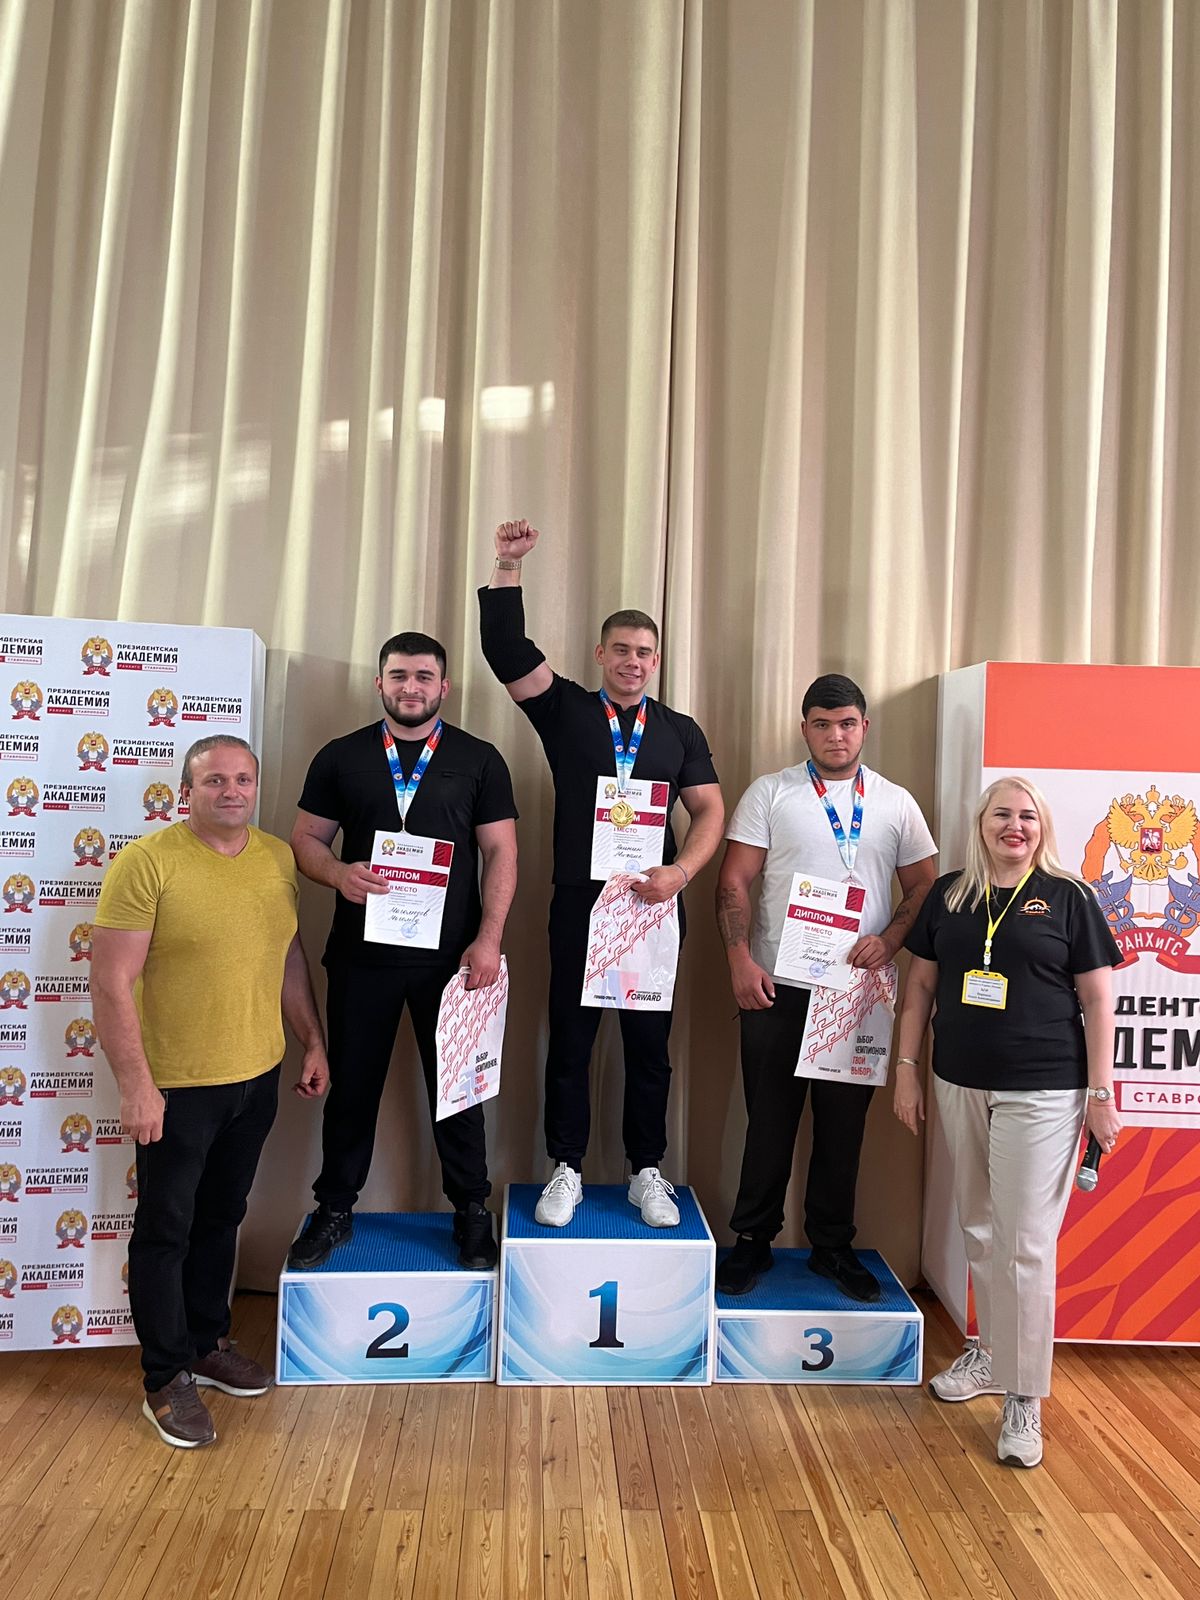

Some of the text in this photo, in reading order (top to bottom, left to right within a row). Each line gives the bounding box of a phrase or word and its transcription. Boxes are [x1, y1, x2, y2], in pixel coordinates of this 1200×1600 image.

[1, 644, 43, 656] ДЕМИЯ
[117, 643, 179, 653] ПРЕЗИДЕНТСКАЯ
[117, 650, 178, 664] АКАДЕМИЯ
[47, 688, 110, 696] ПРЕЗИДЕНТСКАЯ
[47, 694, 110, 708] АКАДЕМИЯ
[182, 695, 242, 703] ПРЕЗИДЕНТСКАЯ
[182, 702, 242, 714] АКАДЕМИЯ
[0, 741, 39, 752] ДЕМИЯ
[113, 739, 174, 747] ПРЕЗИДЕНТСКАЯ
[113, 746, 174, 758] АКАДЕМИЯ
[43, 791, 106, 803] АКАДЕМИЯ
[0, 838, 35, 849] ЕМИЯ
[379, 868, 420, 881] ДИПЛОМ
[40, 887, 101, 898] АКАДЕМИЯ
[794, 908, 834, 924] ДИПЛОМ
[811, 927, 833, 936] МЕСТО
[1115, 932, 1182, 956] РАНХиГС
[35, 983, 90, 993] АКАДЕМИ
[625, 989, 662, 1002] FORWARD
[1114, 996, 1200, 1017] ДЕНТ
[0, 1030, 26, 1041] МИЯ
[857, 1036, 873, 1044] ВЫБОР
[1113, 1026, 1200, 1070] ДЕМ
[30, 1078, 93, 1089] АКАДЕМИЯ
[26, 1174, 88, 1185] АКАДЕМИЯ
[21, 1270, 84, 1281] АКАДЕМИЯ
[87, 1315, 132, 1326] АКАДЕМ
[588, 1280, 625, 1350] 1
[366, 1302, 410, 1359] 2
[800, 1327, 836, 1372] 3
